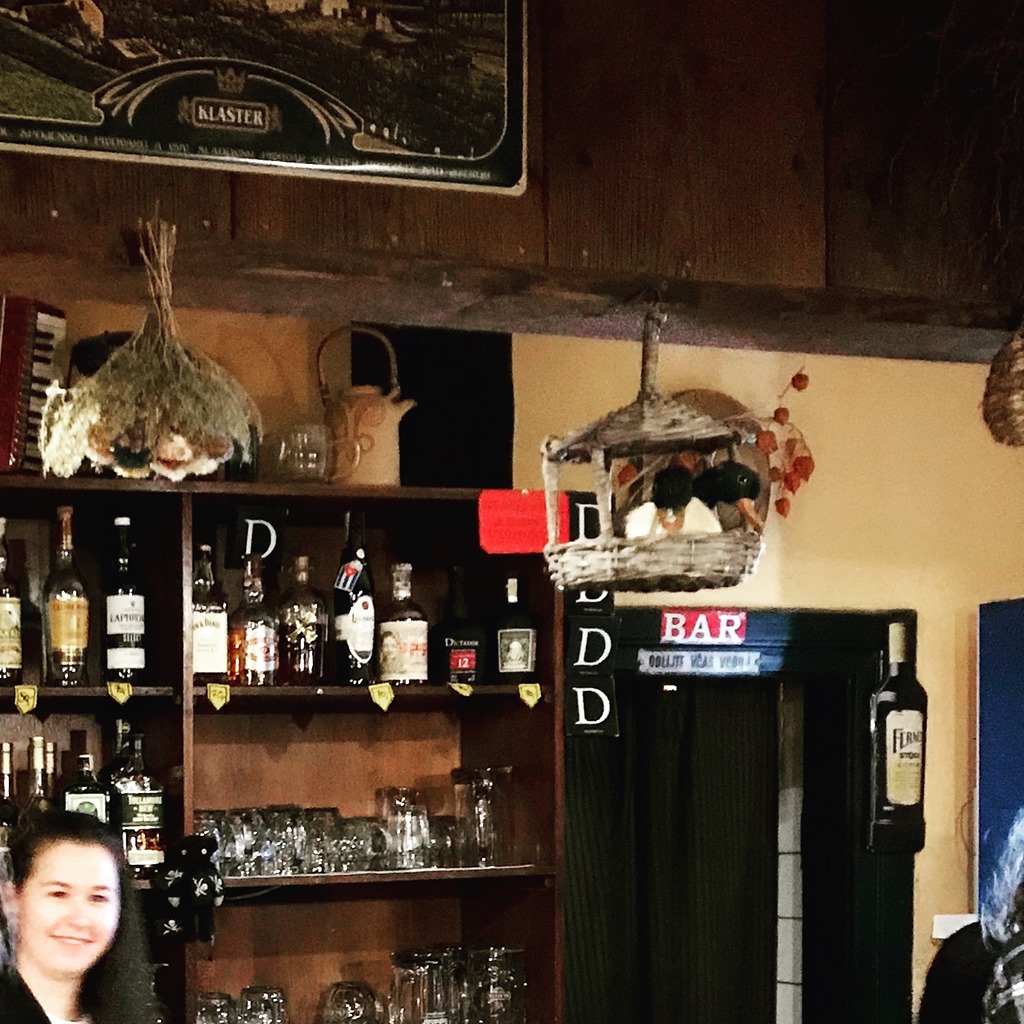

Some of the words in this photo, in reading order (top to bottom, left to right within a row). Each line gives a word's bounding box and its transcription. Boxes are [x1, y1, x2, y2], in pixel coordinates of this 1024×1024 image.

[197, 104, 264, 126] KLASTER
[662, 612, 744, 643] BAR
[573, 627, 612, 666] D
[457, 657, 470, 669] 12
[571, 687, 611, 725] D
